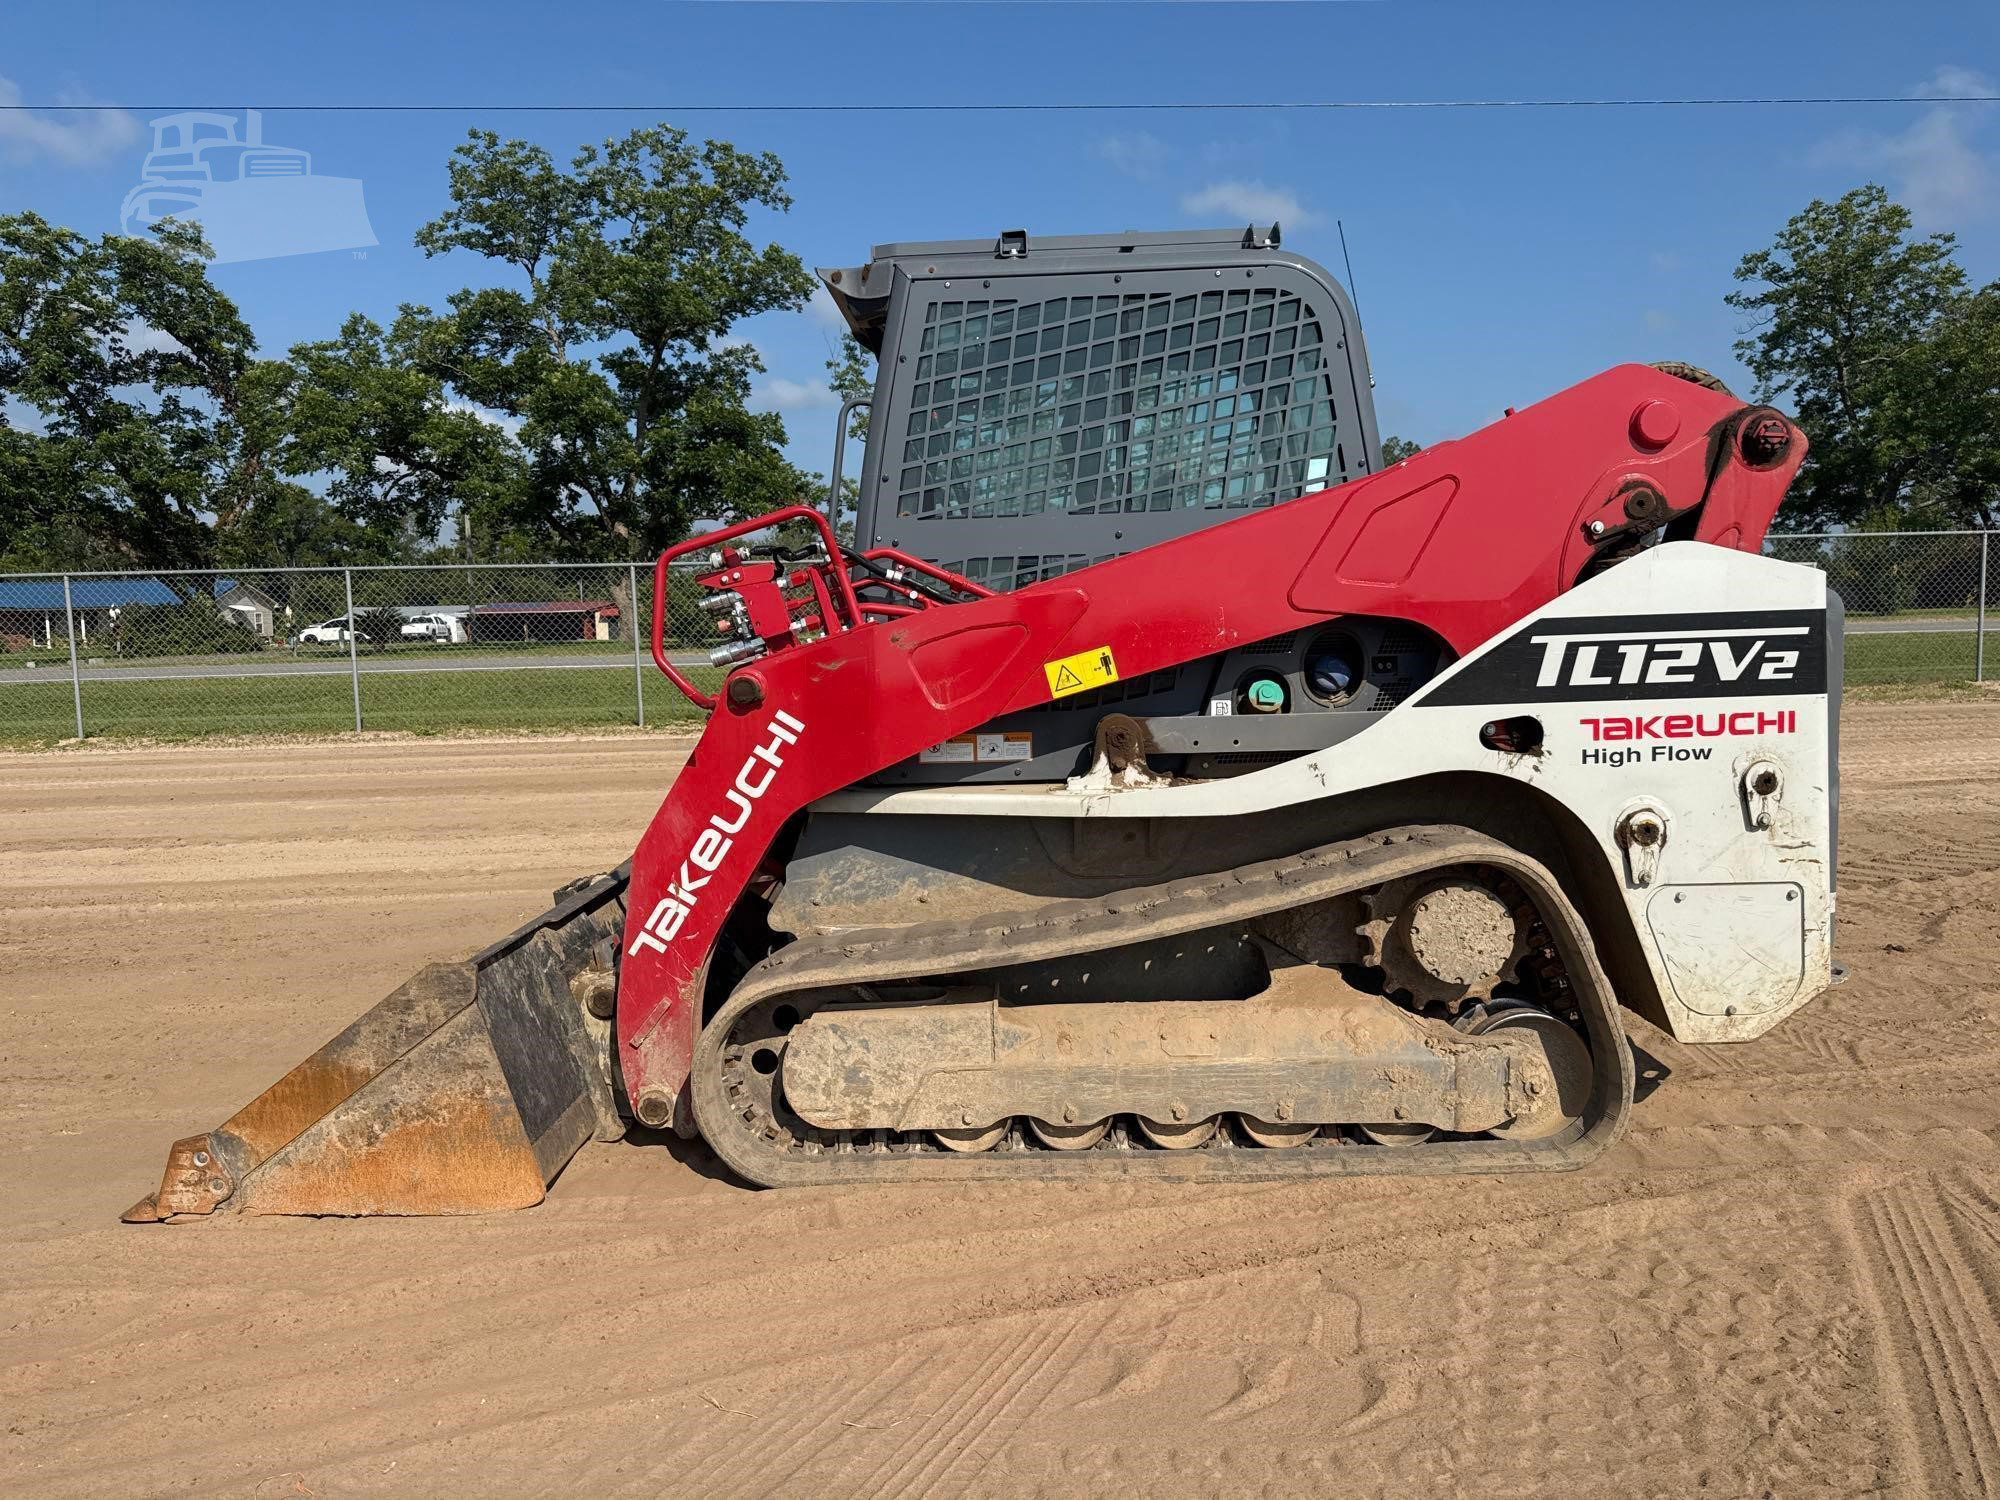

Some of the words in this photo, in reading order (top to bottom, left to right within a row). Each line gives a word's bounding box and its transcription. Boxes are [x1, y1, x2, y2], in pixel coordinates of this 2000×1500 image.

[1530, 626, 1810, 687] TL12V2
[1581, 747, 1641, 767] High
[1651, 746, 1712, 762] Flow
